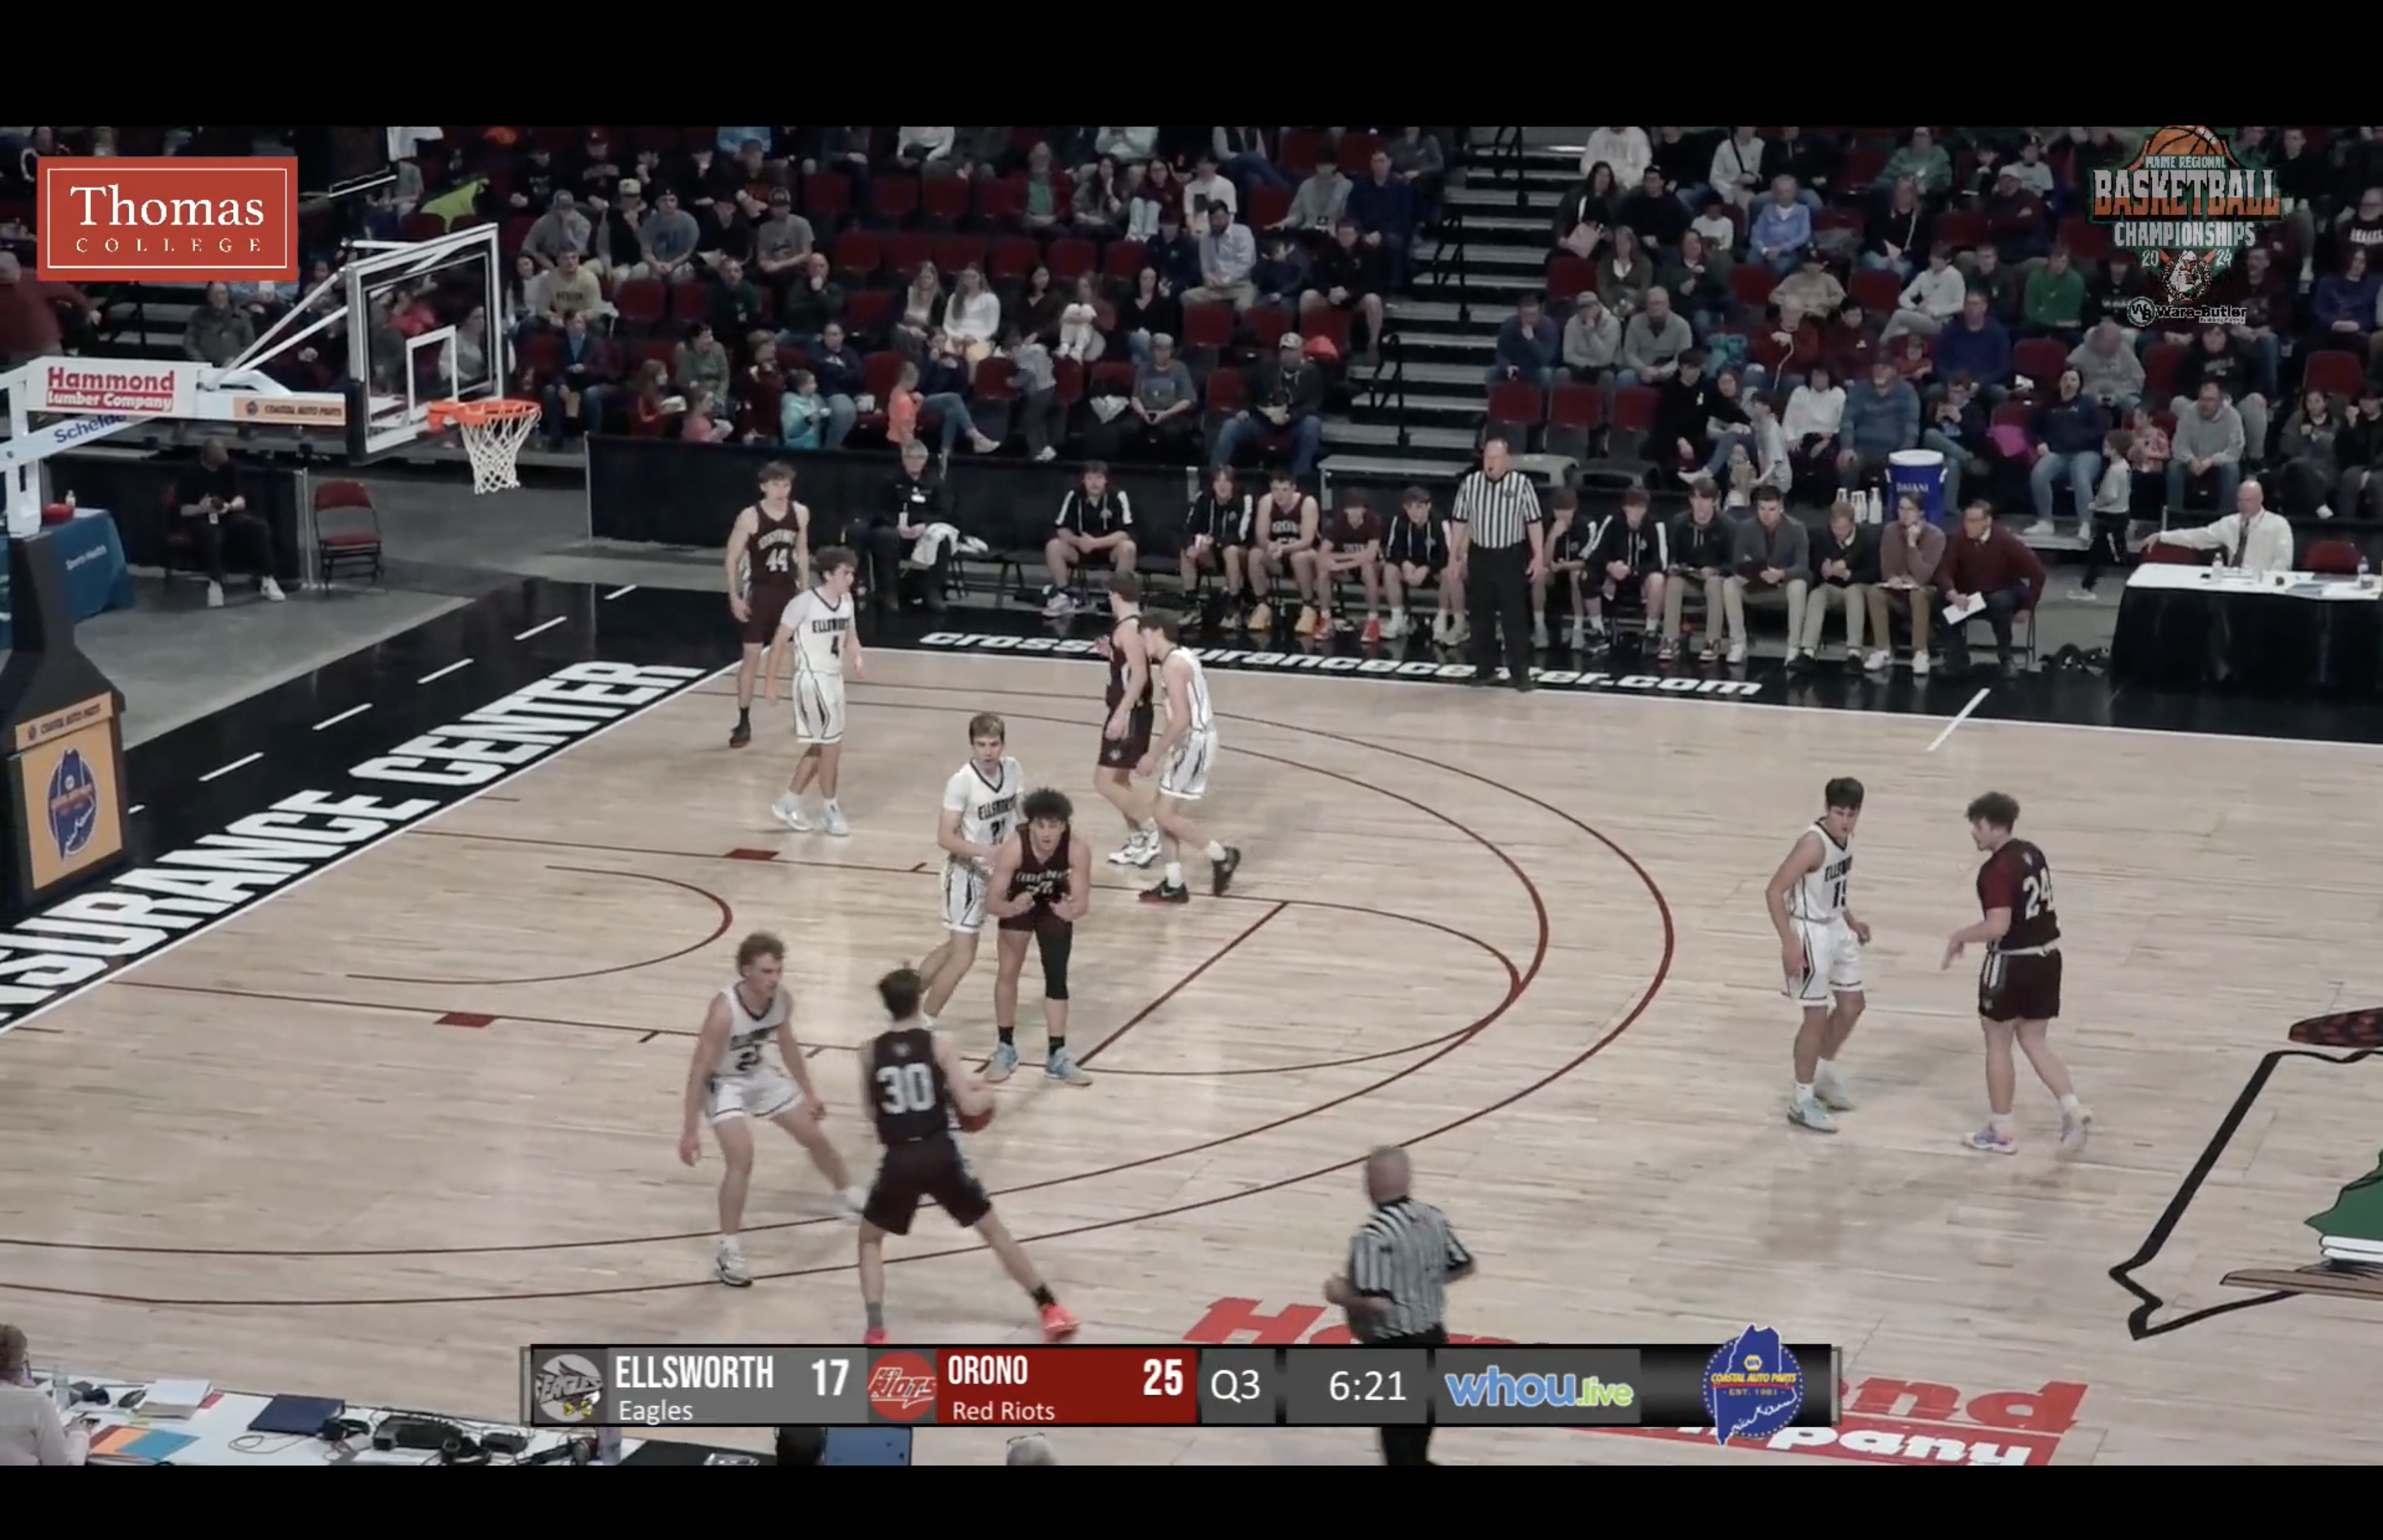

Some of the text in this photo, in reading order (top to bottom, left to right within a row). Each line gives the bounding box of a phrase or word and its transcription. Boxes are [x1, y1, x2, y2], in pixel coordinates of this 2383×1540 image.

[47, 367, 174, 392] Hammond
[47, 392, 173, 412] Lumber Company
[765, 548, 789, 572] 44
[830, 635, 840, 658] 4
[348, 660, 706, 786] CENTER
[2022, 870, 2053, 920] 24
[876, 1063, 936, 1114] 30
